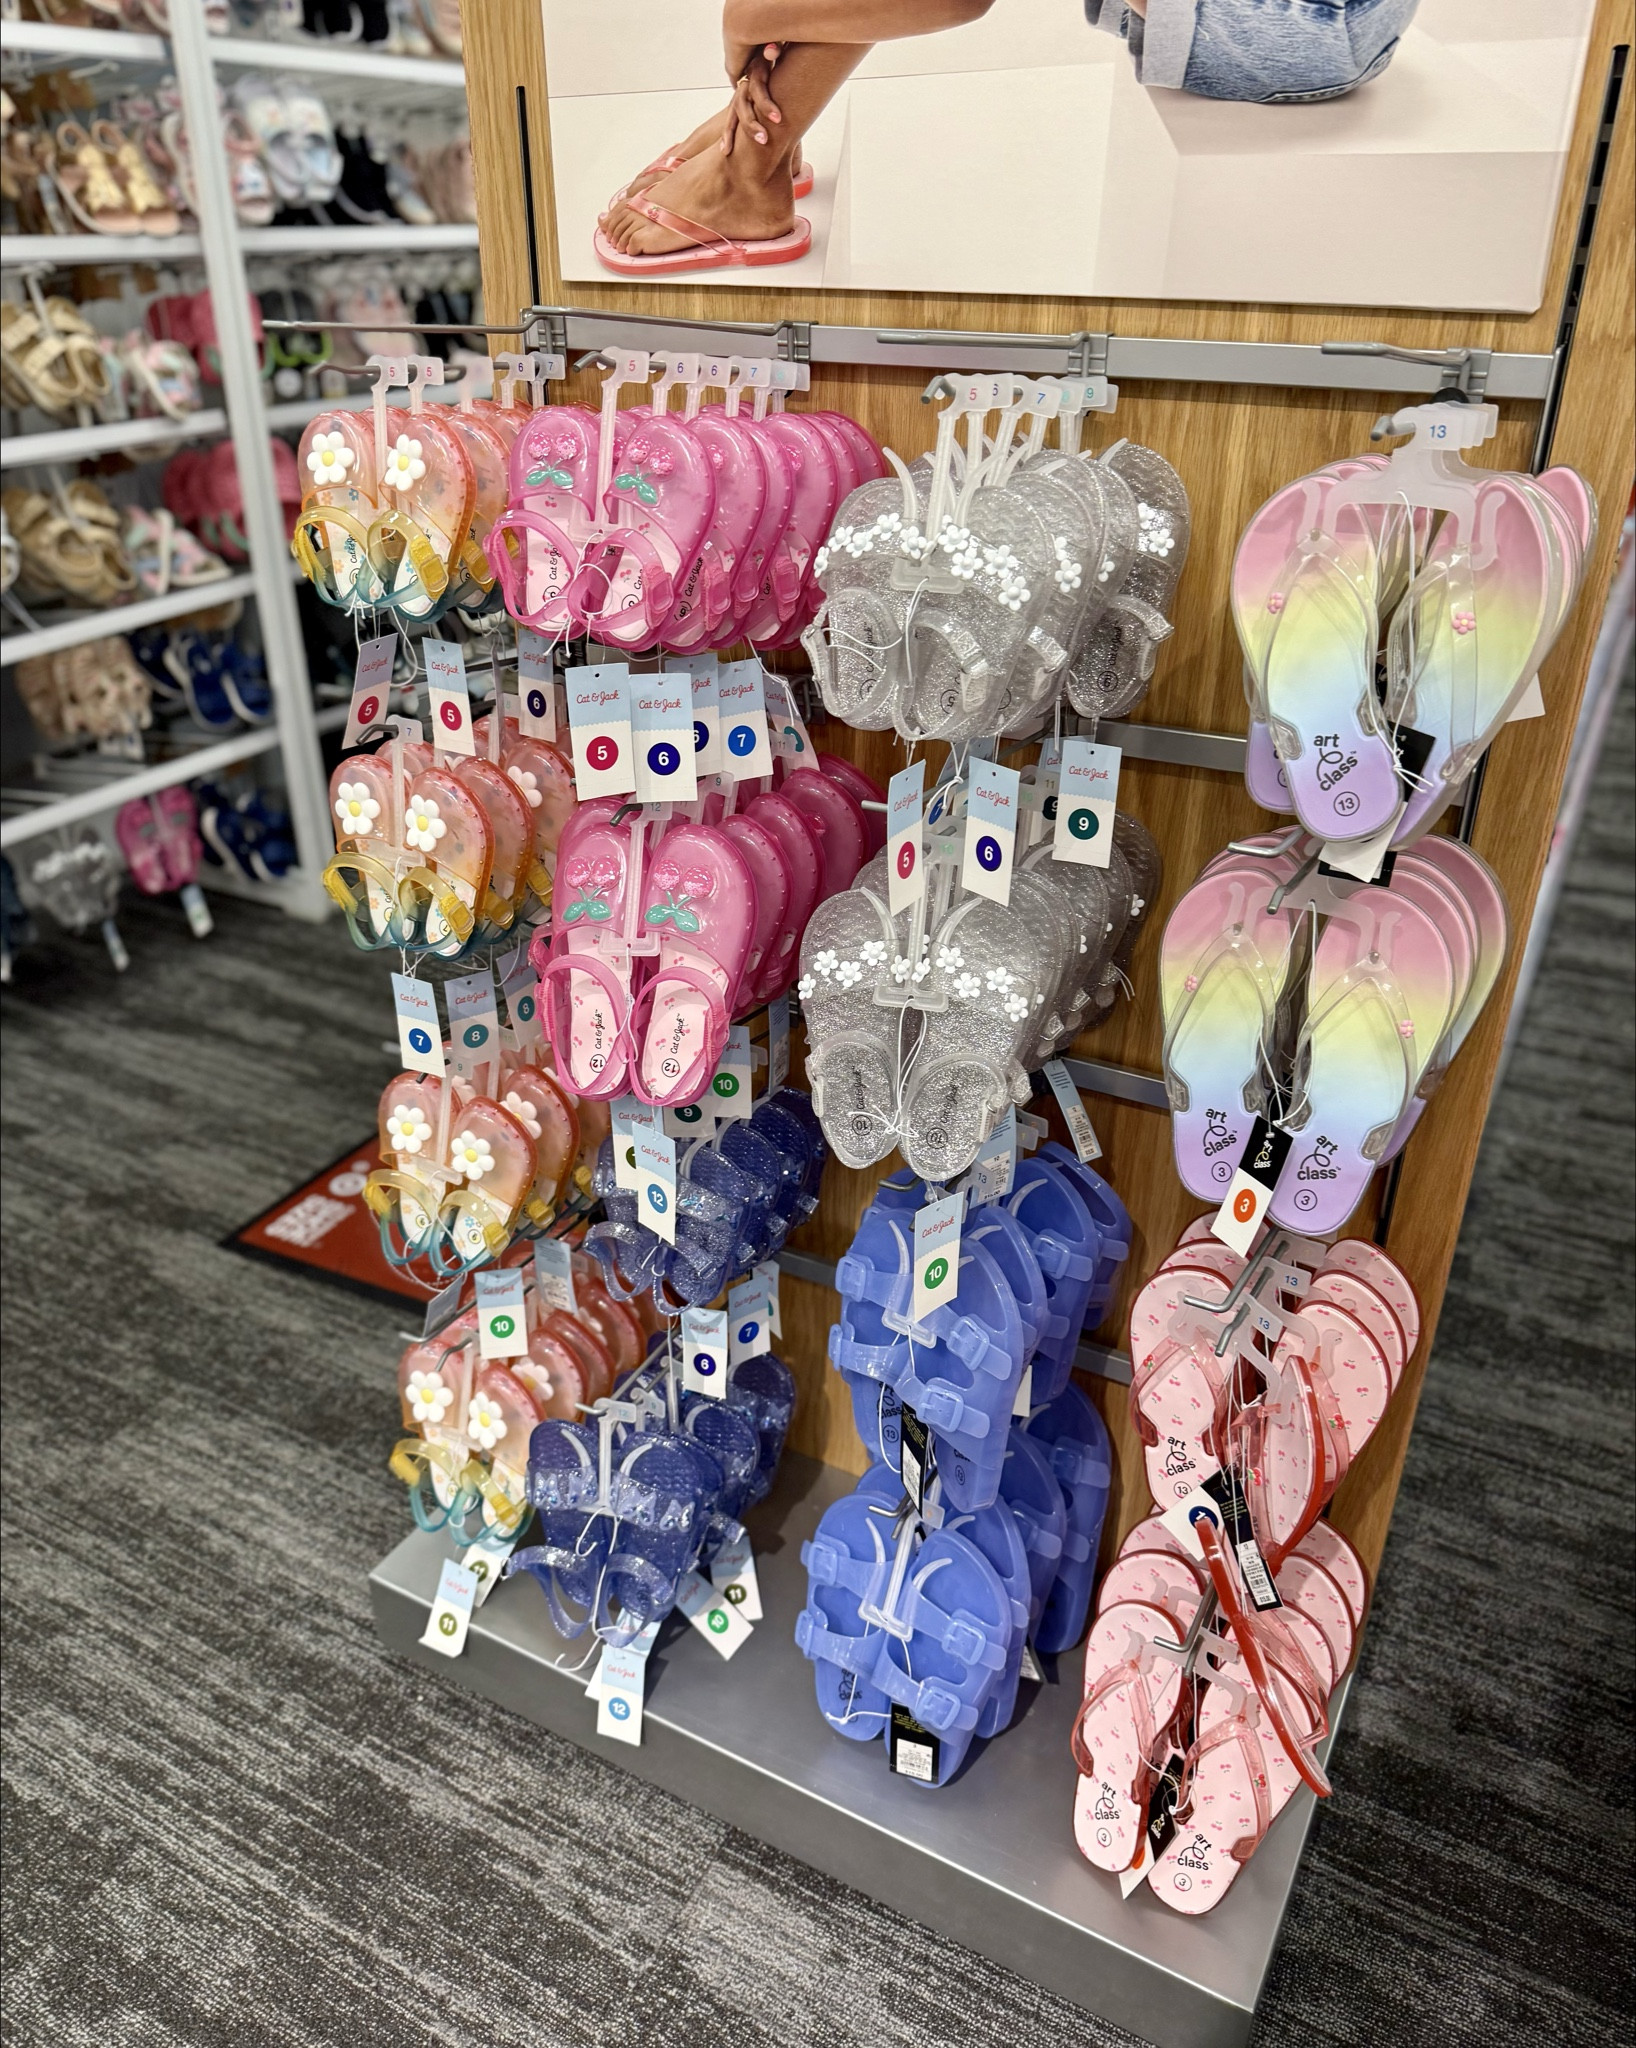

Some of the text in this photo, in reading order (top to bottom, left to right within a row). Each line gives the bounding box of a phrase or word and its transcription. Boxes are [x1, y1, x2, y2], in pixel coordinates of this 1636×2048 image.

[390, 366, 395, 377] 5
[427, 366, 432, 377] 5
[517, 362, 524, 372] 6
[548, 362, 554, 370] 7
[629, 360, 636, 371] 5
[677, 362, 684, 373] 6
[711, 365, 718, 376] 6
[750, 368, 758, 378] 7
[970, 388, 977, 400] 5
[1038, 392, 1046, 404] 7
[1086, 388, 1094, 398] 9
[1429, 425, 1447, 439] 13
[548, 565, 557, 580] Cat
[432, 662, 440, 670] Cat
[446, 664, 459, 676] Jack
[695, 677, 712, 693] Jack
[720, 688, 731, 698] Cat
[738, 682, 755, 698] Jack
[534, 697, 540, 710] 6
[576, 690, 620, 706] Cat & Jack
[946, 696, 956, 708] 5
[364, 704, 373, 716] 5
[639, 698, 682, 712] Cat & Jack
[447, 710, 455, 722] 5
[406, 727, 412, 736] 7
[737, 734, 746, 747] 7
[1314, 734, 1340, 748] art
[598, 746, 608, 760] 5
[658, 752, 669, 766] 6
[1047, 758, 1058, 766] Cat
[1068, 766, 1110, 782] Cat & Jack
[1320, 756, 1358, 791] class
[716, 776, 722, 786] 9
[1046, 780, 1054, 790] 11
[894, 802, 902, 812] Cat
[906, 789, 919, 810] Jack
[976, 786, 988, 798] Cat
[994, 792, 1010, 806] Jack
[650, 802, 661, 812] 12
[1338, 798, 1355, 810] 13
[1078, 816, 1089, 830] 9
[903, 852, 910, 868] 5
[984, 846, 994, 862] 6
[400, 994, 410, 1002] Cat
[415, 998, 430, 1008] Jack
[472, 990, 488, 1004] Jack
[522, 1003, 530, 1014] 8
[594, 1013, 605, 1030] Jack
[416, 1034, 424, 1046] 7
[472, 1031, 480, 1042] 8
[671, 1044, 679, 1054] Cat
[675, 1018, 686, 1036] Jack
[594, 1036, 602, 1050] Cat
[591, 1059, 604, 1068] 12
[664, 1063, 677, 1074] 12
[718, 1079, 732, 1091] 10
[618, 1112, 630, 1120] Cat
[684, 1108, 692, 1117] 9
[1206, 1108, 1227, 1124] art
[856, 1120, 868, 1130] 10
[1204, 1134, 1237, 1157] class
[1263, 1140, 1274, 1152] art
[1316, 1134, 1339, 1156] art
[641, 1145, 652, 1155] Cat
[657, 1152, 670, 1165] Jack
[1254, 1160, 1271, 1169] class
[978, 1172, 987, 1184] 13
[1218, 1167, 1226, 1178] 3
[1297, 1166, 1338, 1181] class
[652, 1190, 664, 1206] 12
[1301, 1195, 1310, 1206] 3
[1240, 1198, 1250, 1213] 3
[922, 1228, 932, 1238] Cat
[937, 1216, 954, 1234] Jack
[929, 1266, 942, 1281] 10
[1285, 1275, 1298, 1287] 13
[495, 1320, 508, 1332] 10
[1258, 1316, 1270, 1330] 13
[746, 1326, 752, 1338] 7
[700, 1358, 709, 1370] 6
[886, 1430, 896, 1440] 13
[1167, 1436, 1186, 1450] art
[1166, 1461, 1196, 1477] class
[1177, 1485, 1188, 1495] 13
[728, 1588, 742, 1600] 11
[443, 1618, 453, 1631] 11
[711, 1614, 724, 1628] 10
[612, 1702, 626, 1716] 12
[1101, 1781, 1116, 1799] art
[1094, 1809, 1120, 1820] class
[1101, 1833, 1108, 1842] 3
[1196, 1834, 1212, 1851] art
[1178, 1856, 1210, 1870] class
[1179, 1878, 1186, 1887] 3
